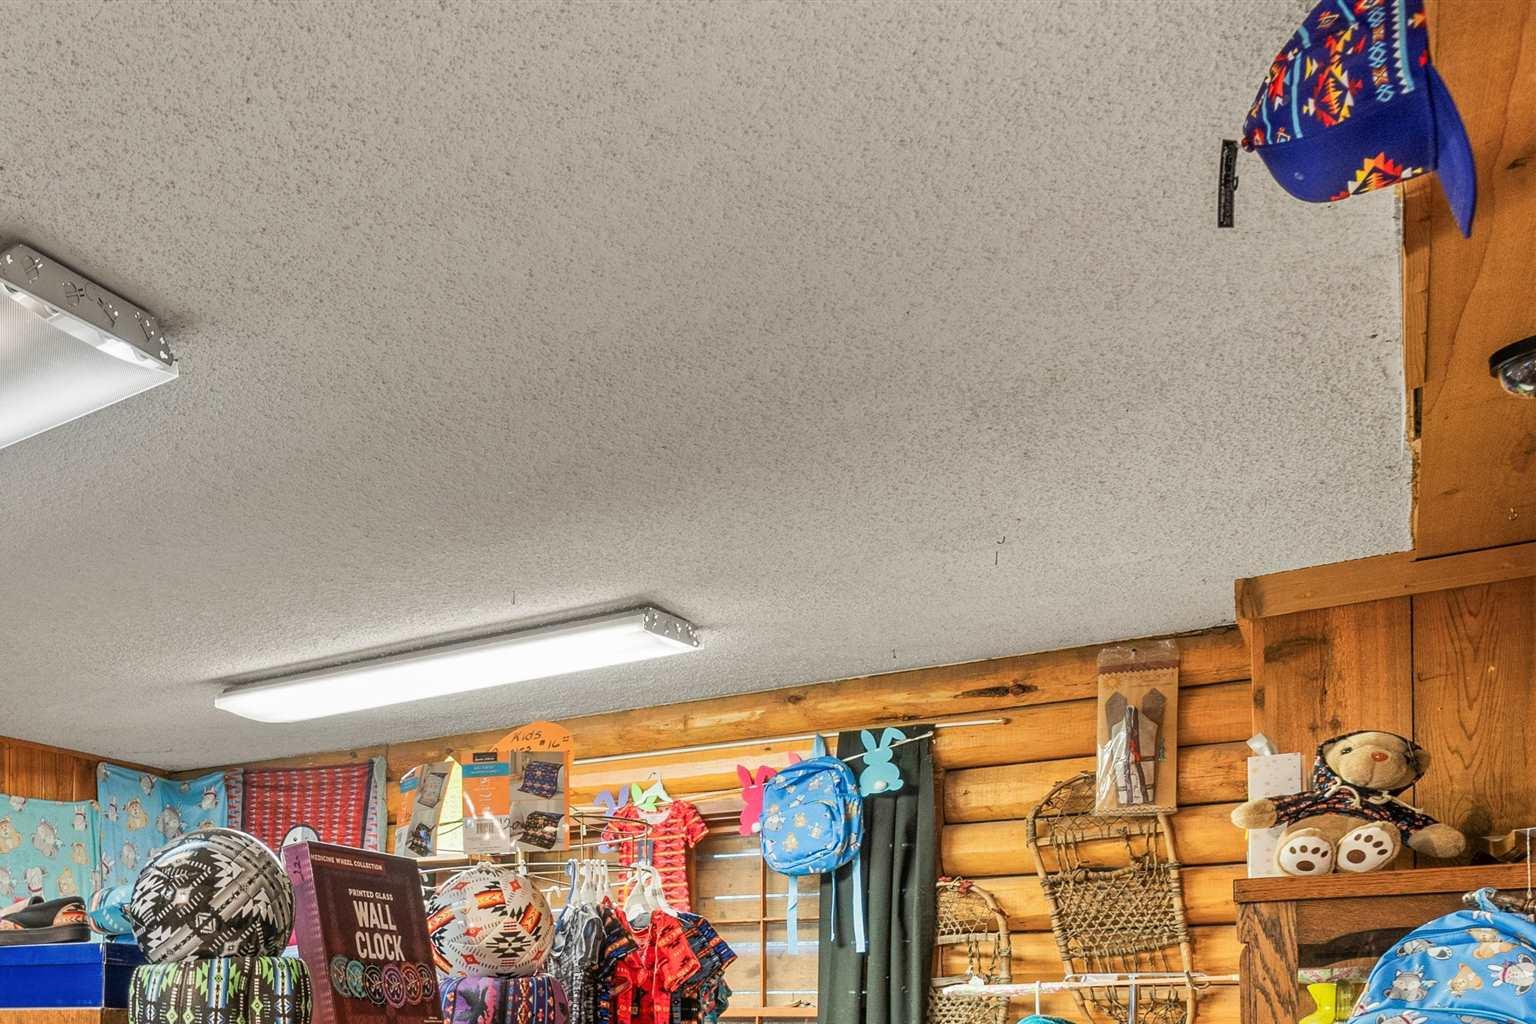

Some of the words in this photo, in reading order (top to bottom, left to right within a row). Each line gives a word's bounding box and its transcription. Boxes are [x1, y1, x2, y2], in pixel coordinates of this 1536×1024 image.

[310, 853, 335, 864] MEDICINE
[335, 857, 353, 867] WHEEL
[353, 860, 383, 870] COLLECTION
[348, 888, 374, 899] PRINTED
[375, 890, 394, 901] GLASS
[352, 900, 397, 931] WALL
[355, 931, 406, 962] CLOCK
